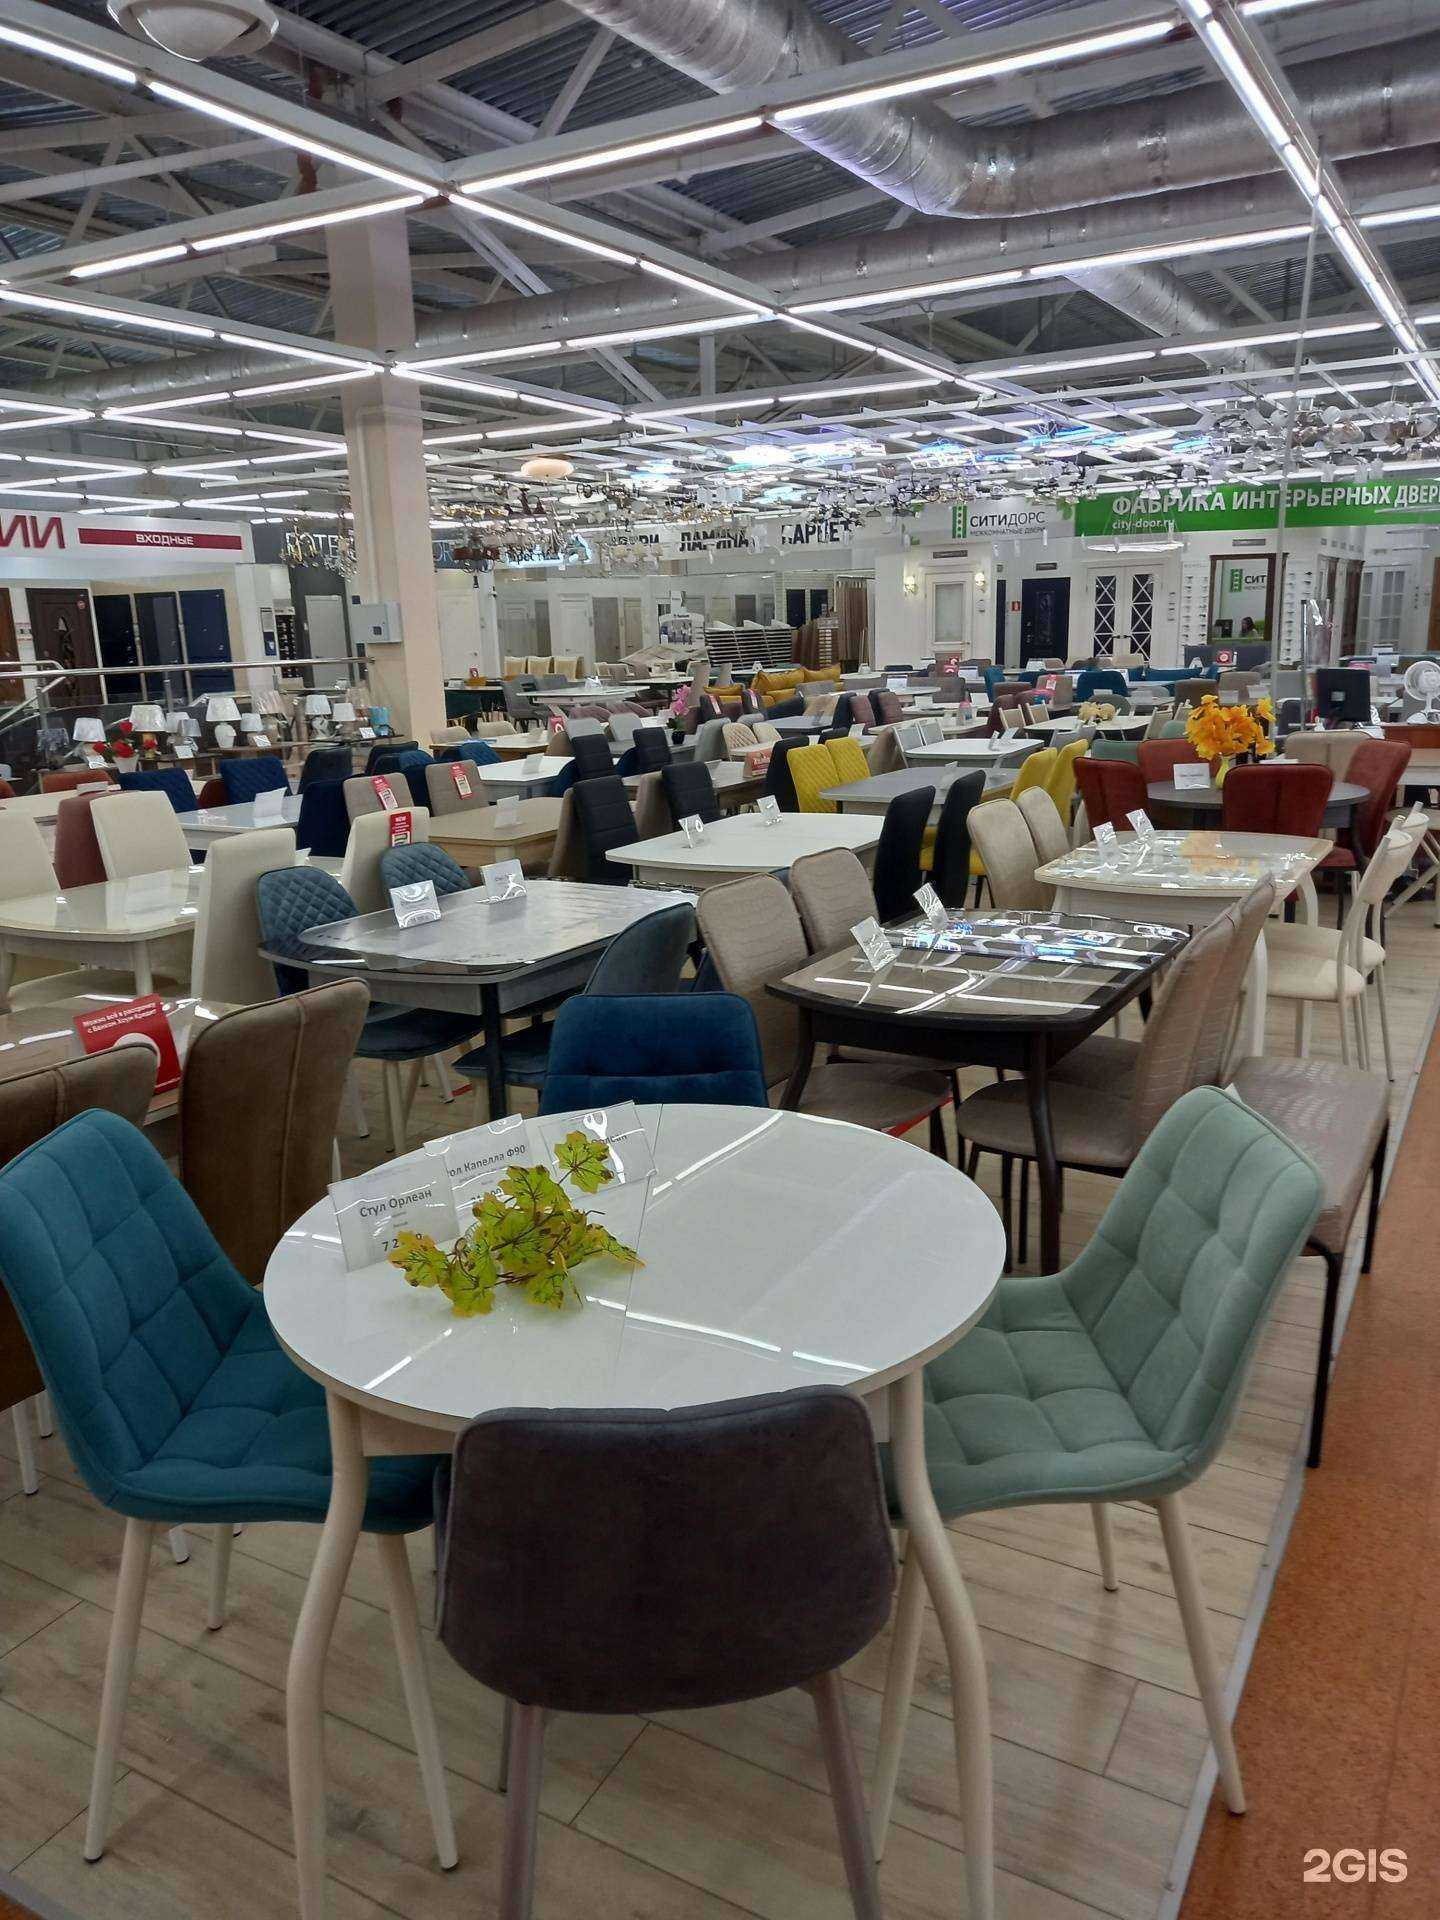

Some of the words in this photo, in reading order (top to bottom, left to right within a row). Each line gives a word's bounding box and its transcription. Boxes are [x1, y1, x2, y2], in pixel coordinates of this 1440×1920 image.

[1112, 492, 1226, 515] ФАБРИКА
[1232, 486, 1391, 509] ИНТЕРЬЕРНЫХ
[1394, 485, 1440, 508] ДВЕР
[970, 511, 1046, 528] СИТИДОРС
[1112, 517, 1176, 530] city-door.ru
[135, 533, 194, 546] ВХОДНЫЕ
[464, 1152, 505, 1174] Капелла
[360, 1203, 386, 1217] Стул
[389, 1189, 432, 1209] Орлеан
